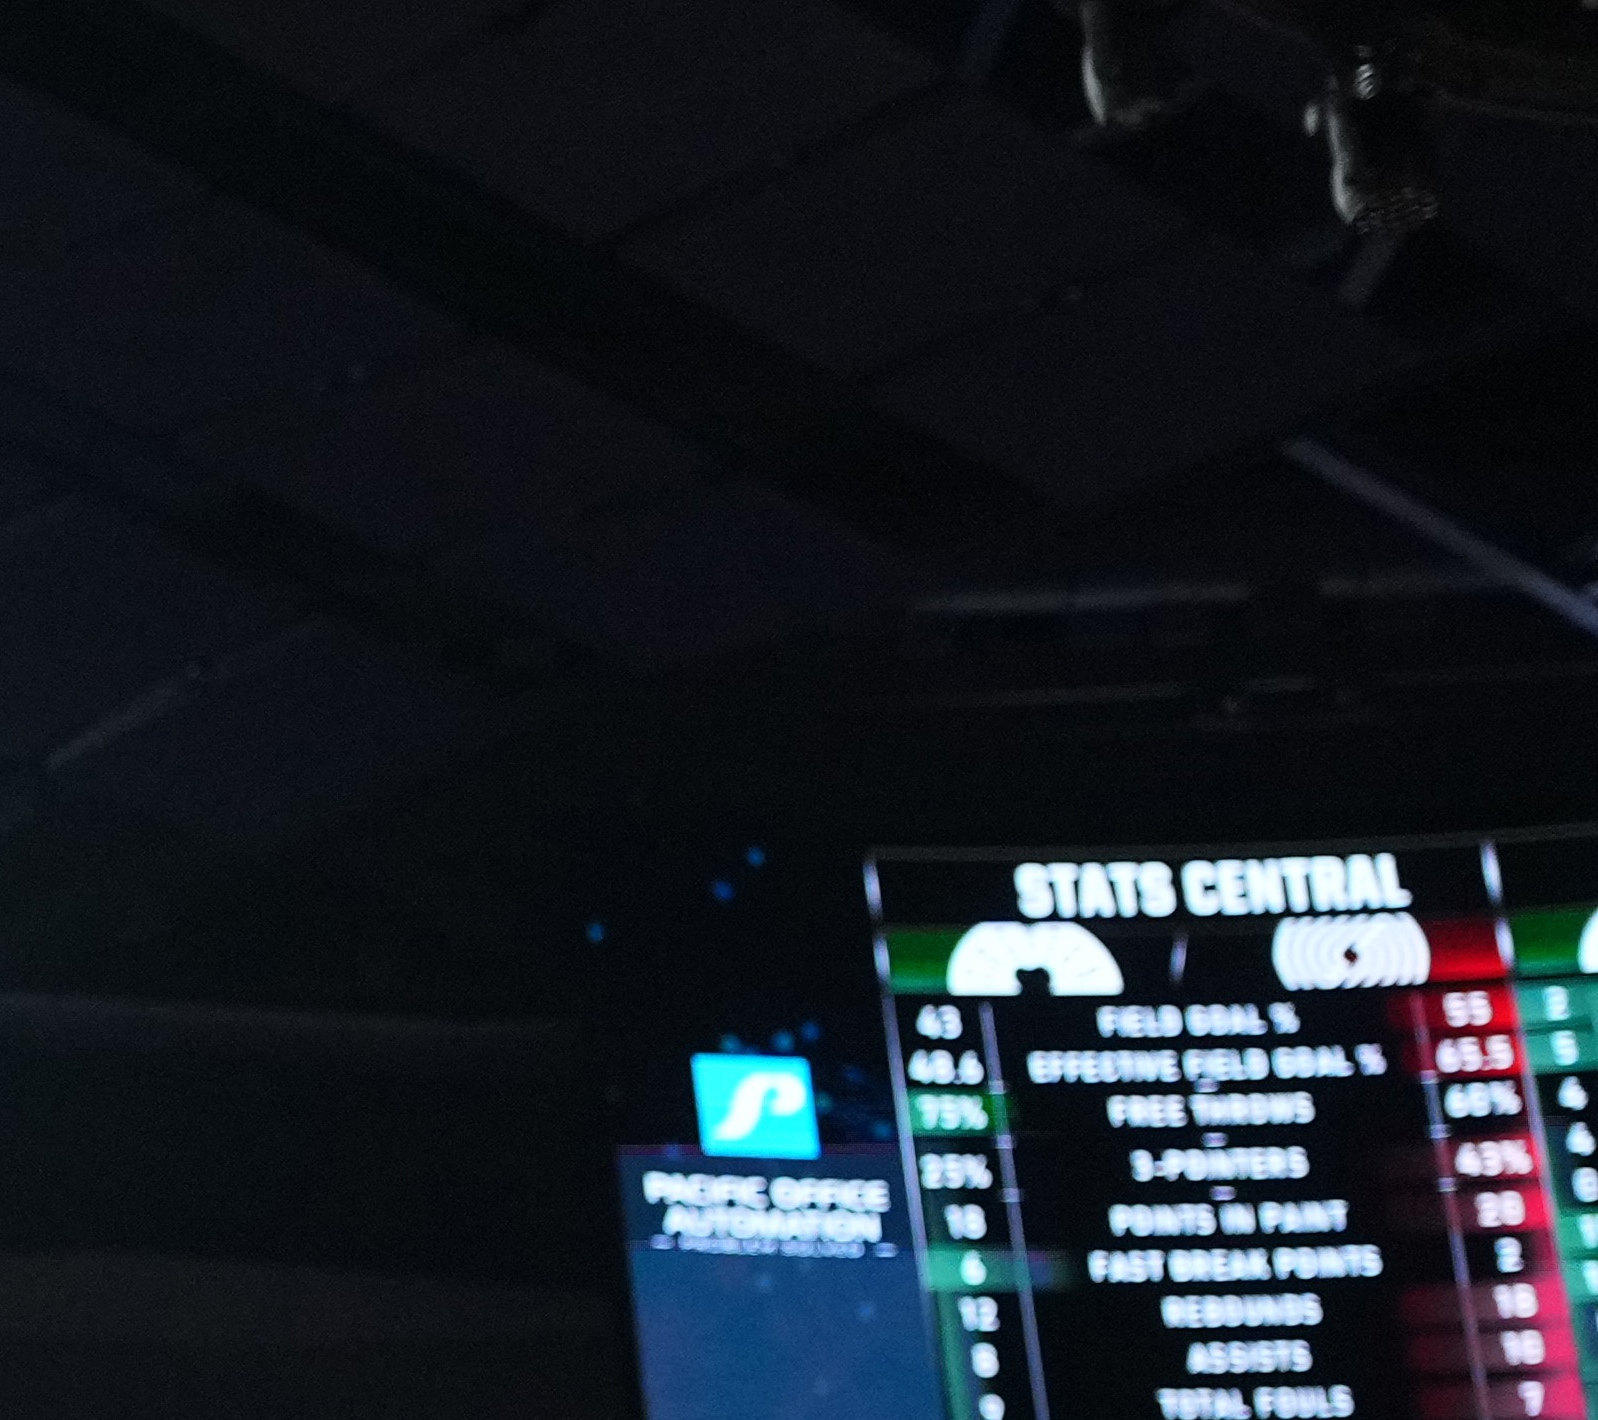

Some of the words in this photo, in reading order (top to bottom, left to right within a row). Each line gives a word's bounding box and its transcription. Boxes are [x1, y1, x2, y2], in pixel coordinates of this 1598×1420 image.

[1014, 861, 1177, 918] STATS
[1181, 852, 1412, 916] CENTRAL
[1097, 1005, 1183, 1038] FIELD
[1185, 1003, 1268, 1036] GOAL
[1267, 1002, 1300, 1034] %
[1443, 991, 1493, 1027] 55
[1027, 1050, 1182, 1084] EFFECTIVE
[1182, 1048, 1268, 1082] FIELD
[1270, 1046, 1355, 1078] GOAL
[1355, 1043, 1386, 1076] %
[1107, 1094, 1189, 1127] FREE
[1189, 1091, 1316, 1126] THROWS
[1130, 1145, 1310, 1183] 3-POINTERS
[642, 1170, 770, 1210] PACIFIC
[769, 1176, 892, 1213] OFFICE
[662, 1204, 883, 1243] AUTOMATION
[1108, 1203, 1217, 1236] POINTS
[1219, 1202, 1257, 1235] IN
[1258, 1199, 1349, 1233] PAINT
[1088, 1249, 1166, 1283] FAST
[1167, 1248, 1271, 1281] BREAK
[1272, 1245, 1384, 1279] POINTS
[1160, 1293, 1323, 1328] REBOUNDS
[1186, 1339, 1313, 1374] ASSISTS
[1155, 1386, 1252, 1420] TOTAL
[1252, 1384, 1356, 1419] FOULS
